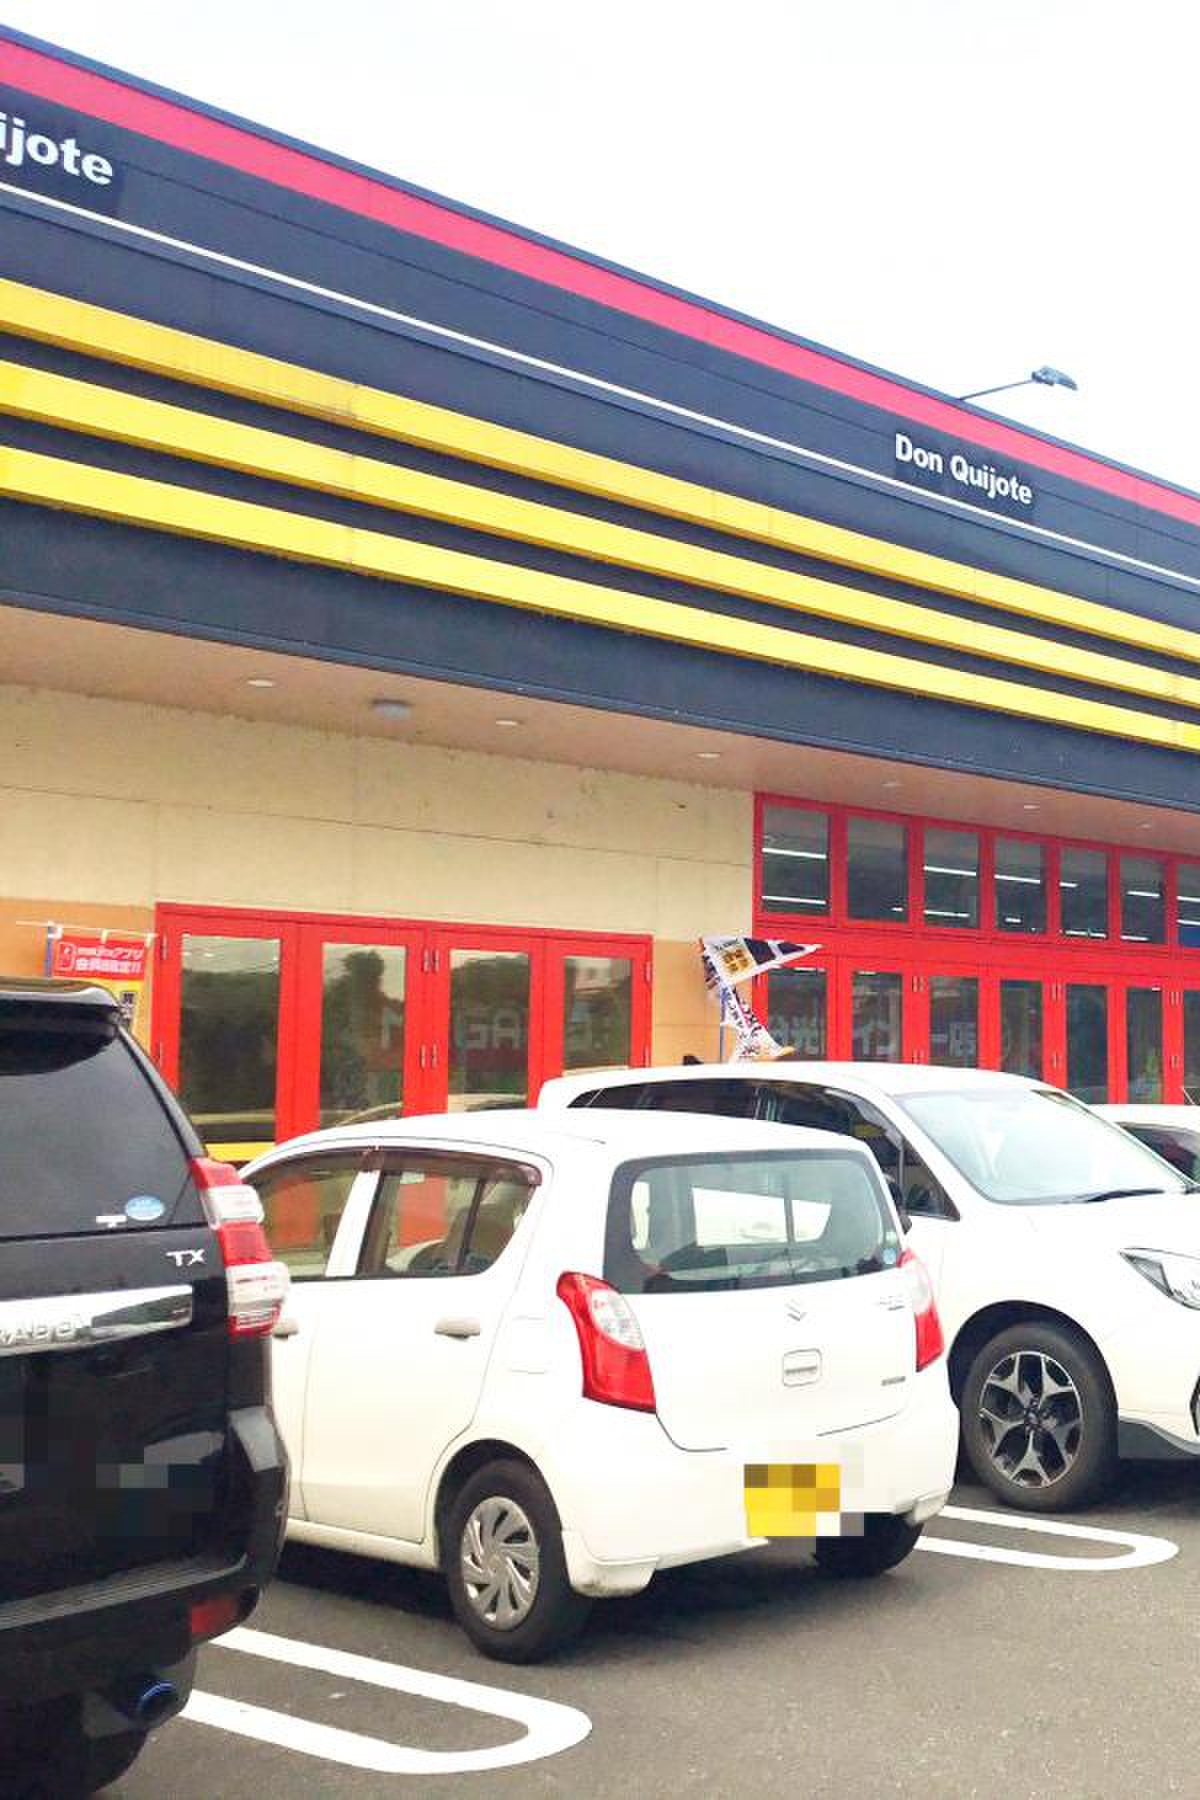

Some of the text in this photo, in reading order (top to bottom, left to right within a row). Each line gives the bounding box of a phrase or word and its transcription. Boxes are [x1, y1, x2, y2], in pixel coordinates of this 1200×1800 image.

[896, 433, 1033, 504] Don Quijote
[166, 1249, 206, 1266] TX
